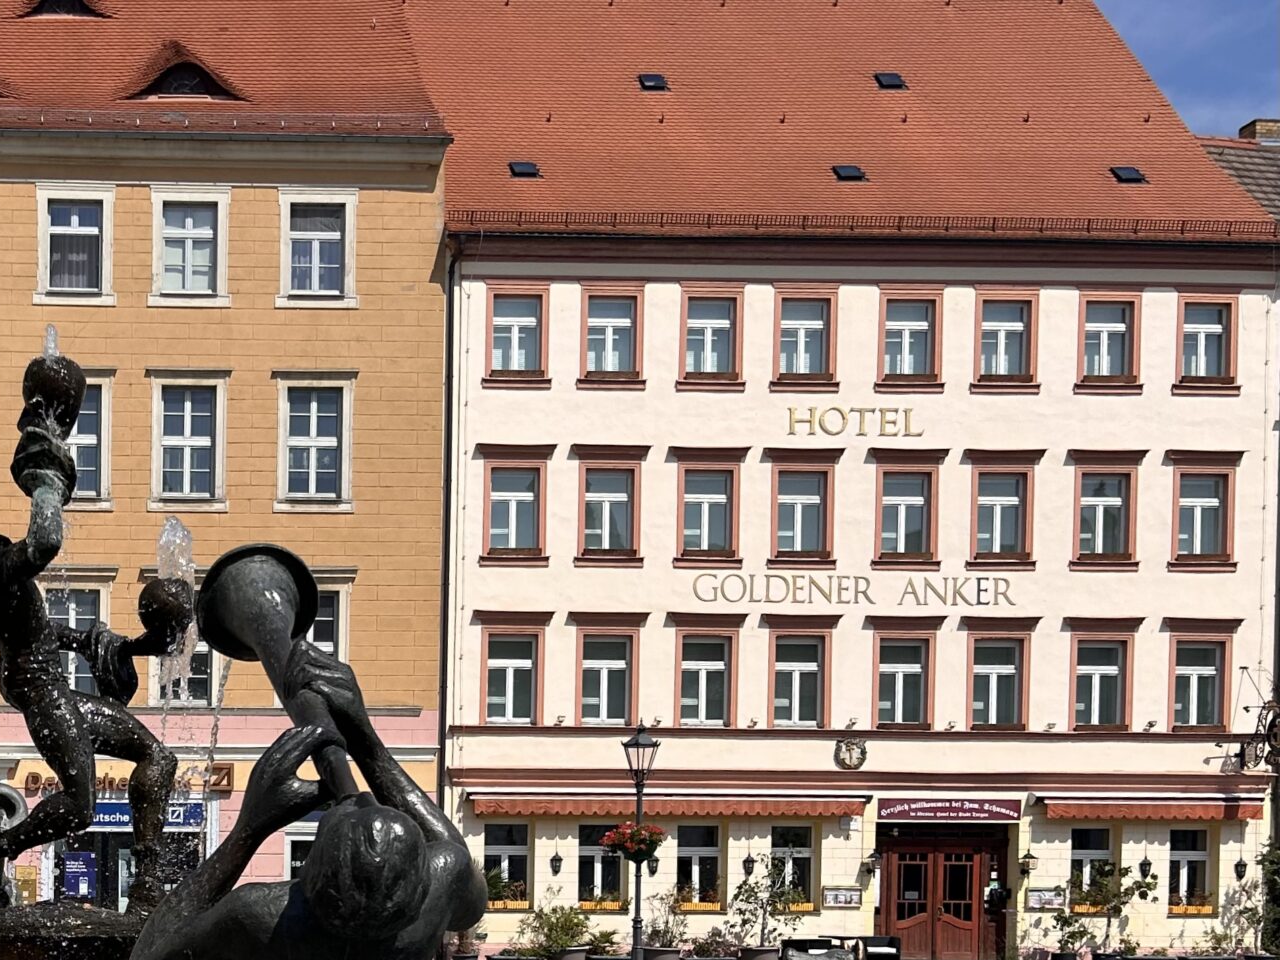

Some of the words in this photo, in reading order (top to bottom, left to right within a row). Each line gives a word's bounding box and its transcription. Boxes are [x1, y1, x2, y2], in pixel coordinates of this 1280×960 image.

[787, 407, 924, 437] HOTEL
[692, 574, 876, 604] GOLDENER
[897, 577, 1016, 606] ANKER
[93, 812, 130, 822] utsche
